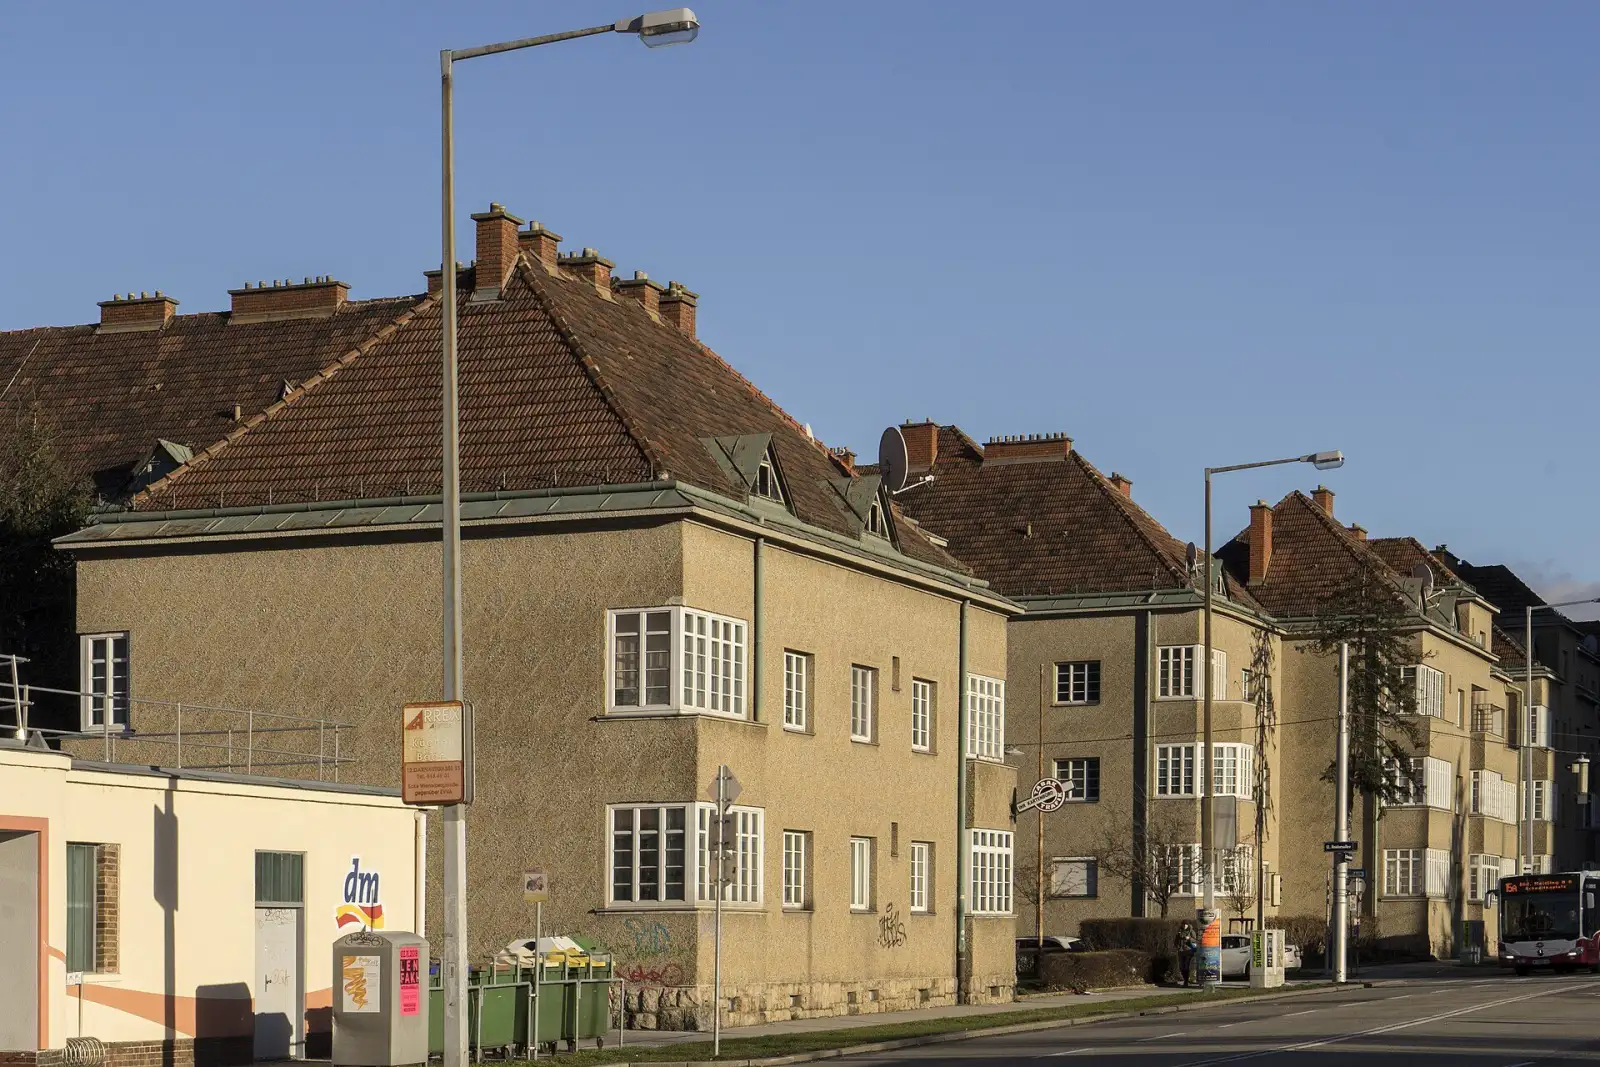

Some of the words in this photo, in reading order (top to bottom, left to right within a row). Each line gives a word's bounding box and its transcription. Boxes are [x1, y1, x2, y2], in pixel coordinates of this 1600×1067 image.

[405, 707, 460, 730] ARREX
[1034, 780, 1057, 795] TABAK
[1040, 792, 1063, 810] TRAFIK
[344, 858, 379, 903] dm
[400, 960, 418, 971] LEN
